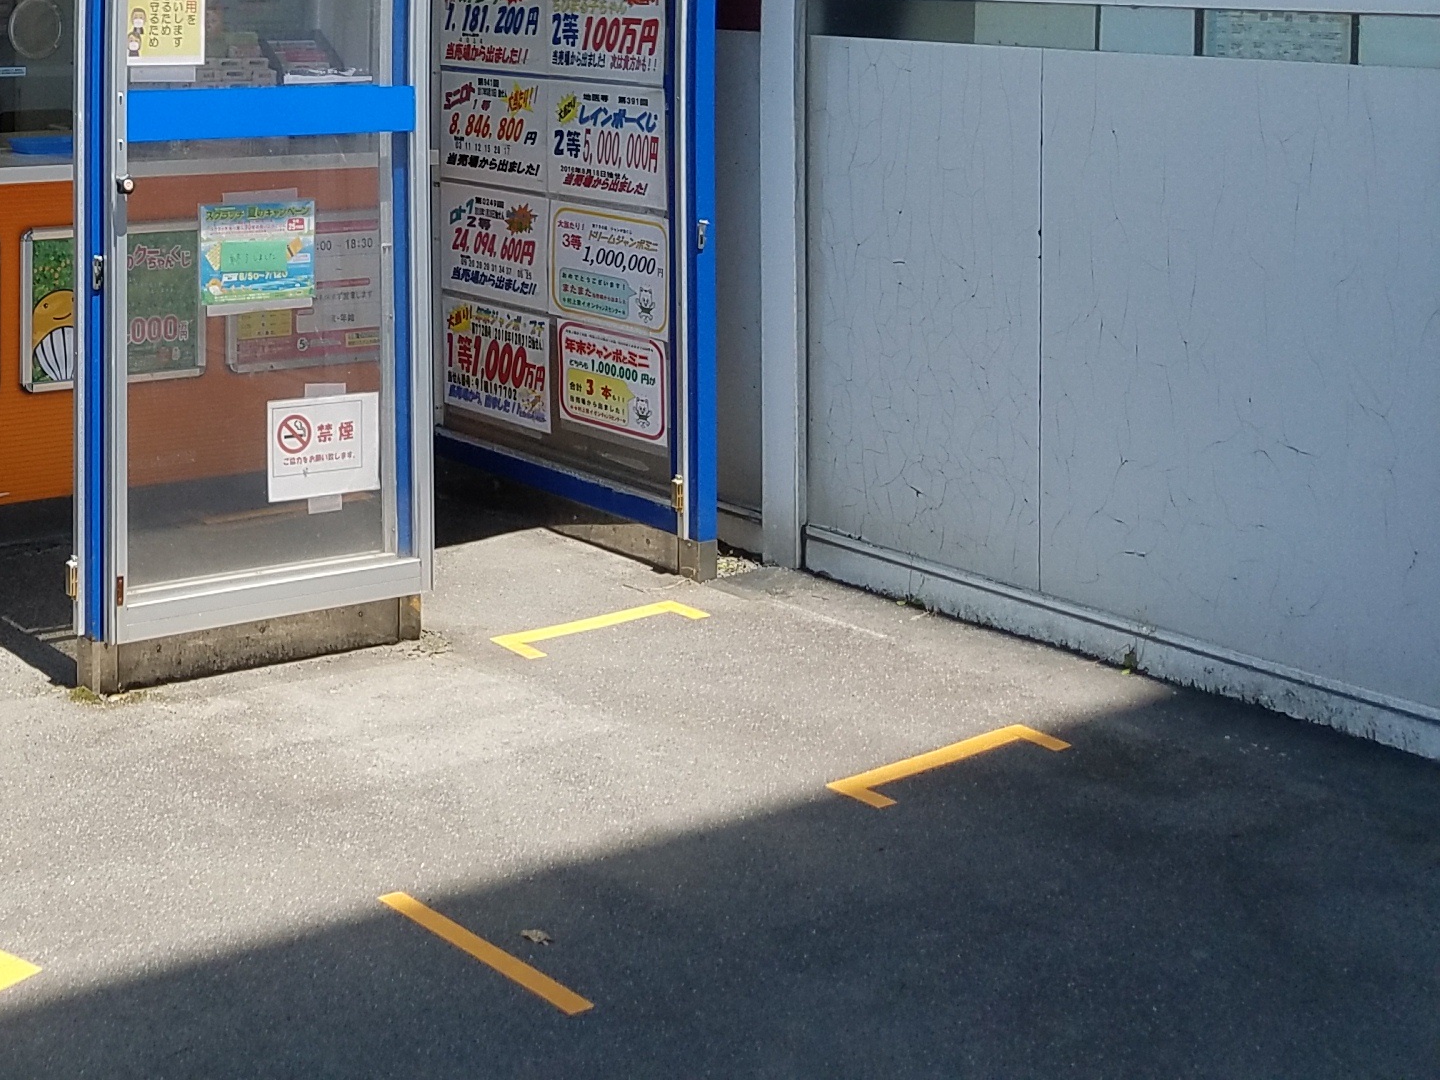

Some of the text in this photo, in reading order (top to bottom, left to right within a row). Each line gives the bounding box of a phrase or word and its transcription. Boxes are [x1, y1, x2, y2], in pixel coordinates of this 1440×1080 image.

[582, 16, 659, 56] 100万円
[578, 104, 659, 134] レインボーくじ
[553, 129, 581, 159] 2等
[345, 238, 373, 249] 18:30
[582, 246, 656, 275] 1,000,000
[586, 378, 594, 395] 3
[317, 420, 354, 443] 禁煙
